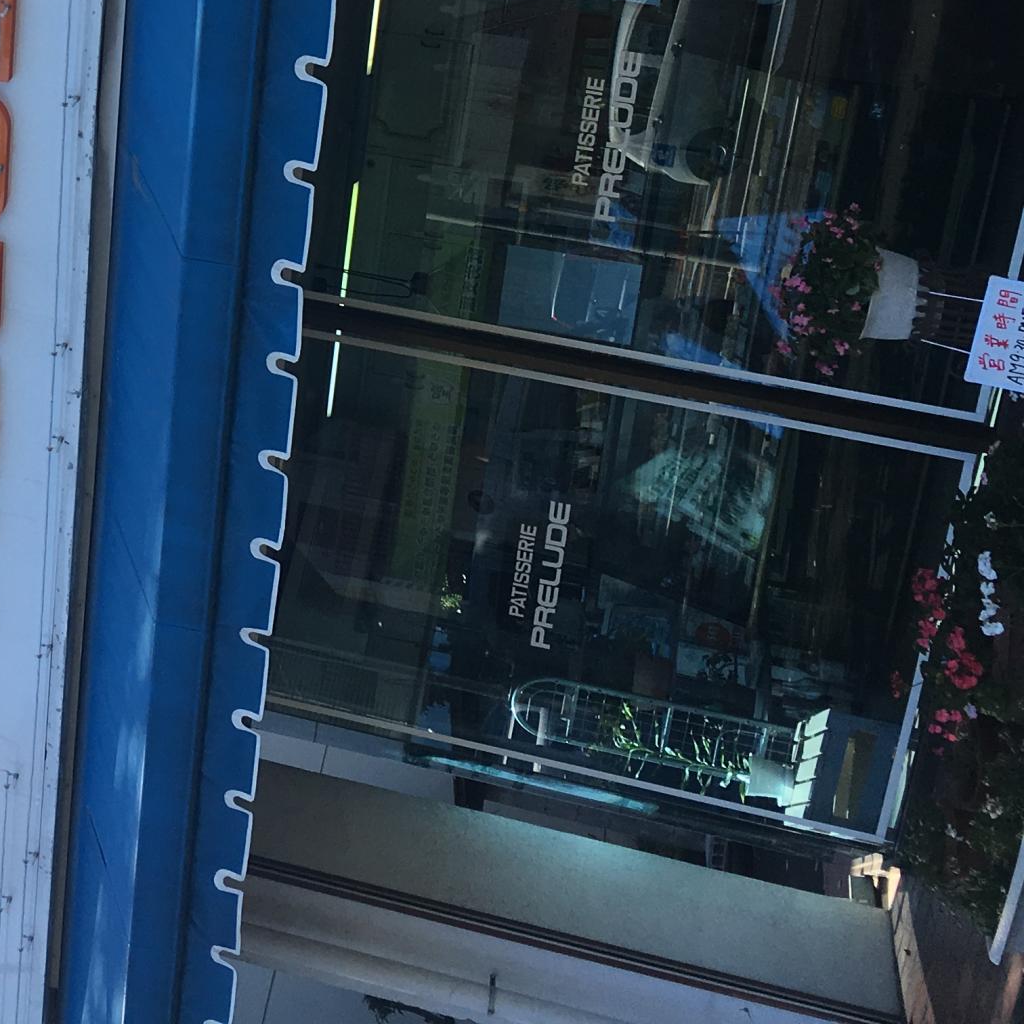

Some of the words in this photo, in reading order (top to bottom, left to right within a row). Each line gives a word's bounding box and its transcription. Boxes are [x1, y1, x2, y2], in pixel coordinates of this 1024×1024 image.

[571, 77, 606, 186] PATISSERIE
[594, 49, 642, 222] PRELUDE
[977, 289, 1023, 371] 営業時間
[508, 524, 538, 618] PATISSERIE
[530, 500, 572, 650] PRELUDE
